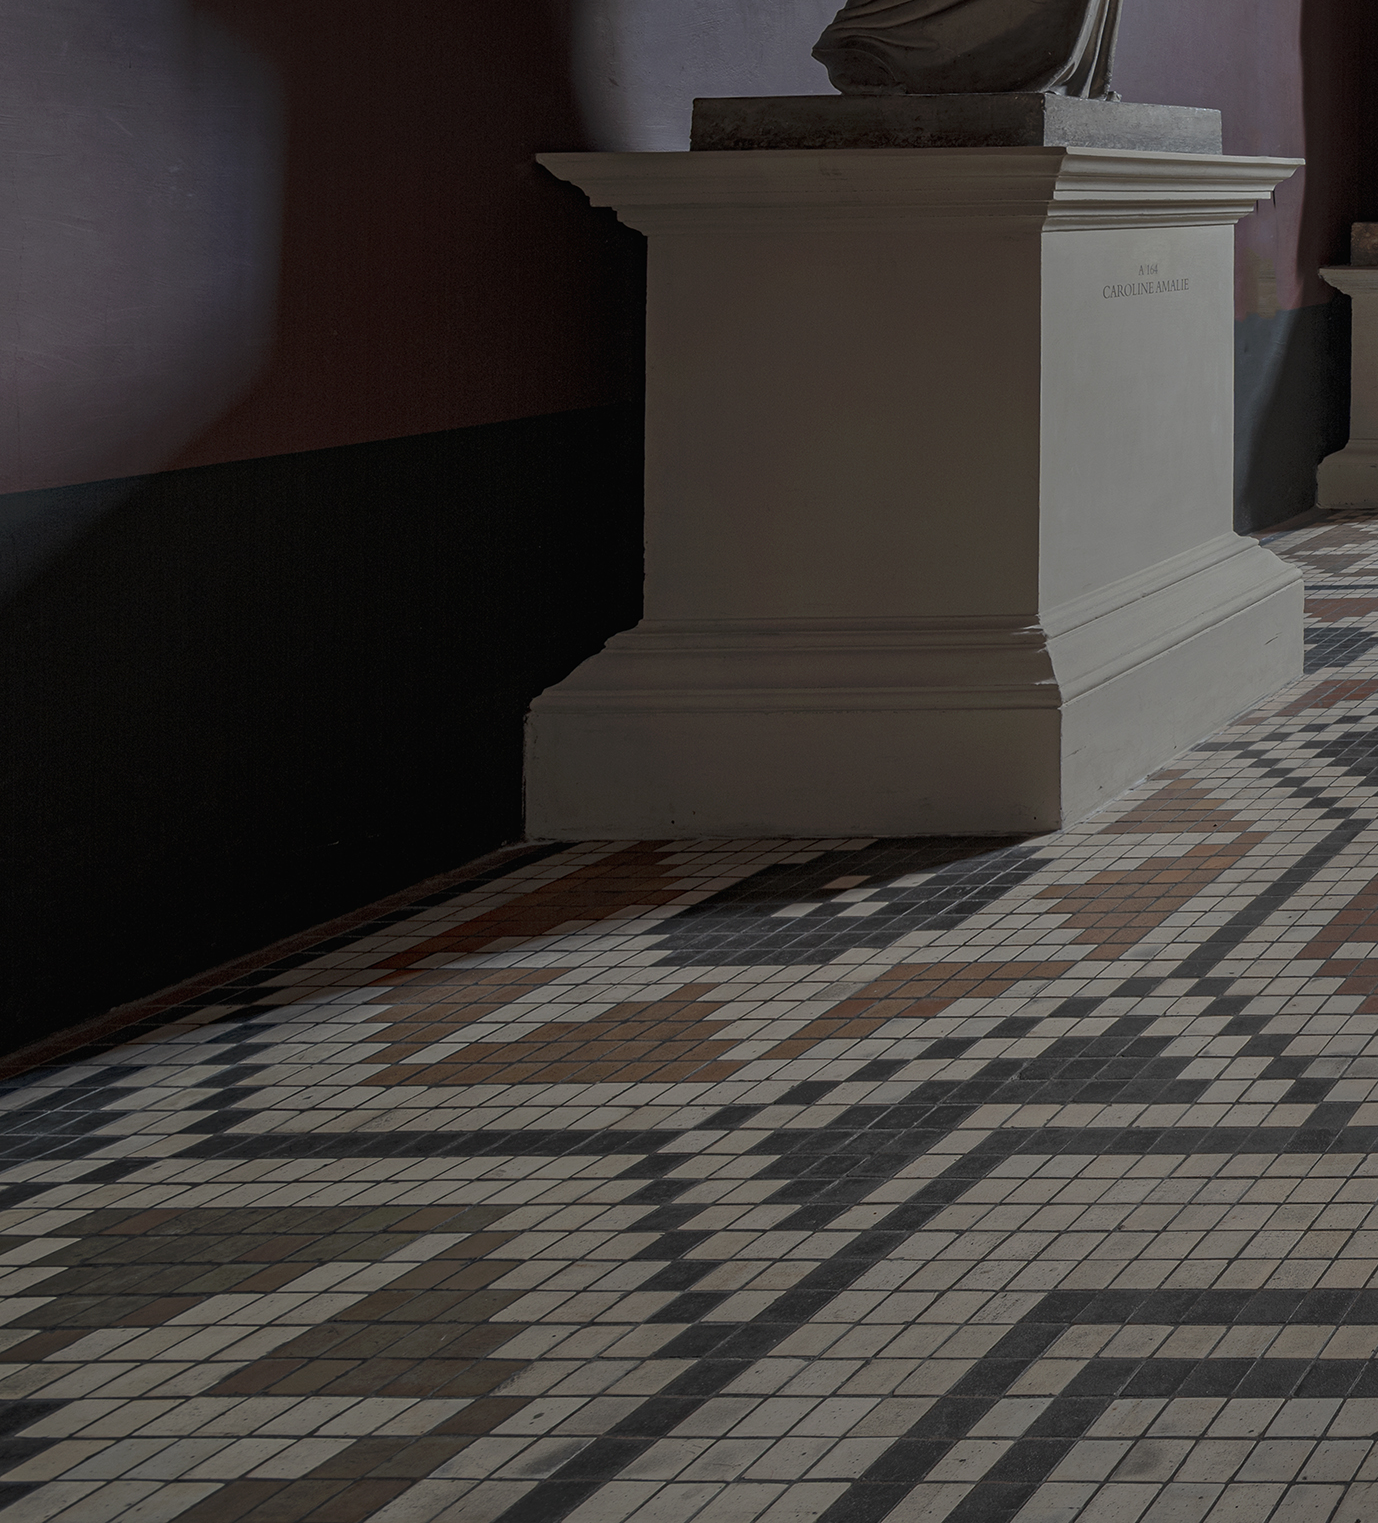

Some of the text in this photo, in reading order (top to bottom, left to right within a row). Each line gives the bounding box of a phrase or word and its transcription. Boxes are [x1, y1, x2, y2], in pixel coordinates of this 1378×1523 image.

[1138, 264, 1158, 276] A 164
[1102, 278, 1189, 299] CAROLINE AMALIE
